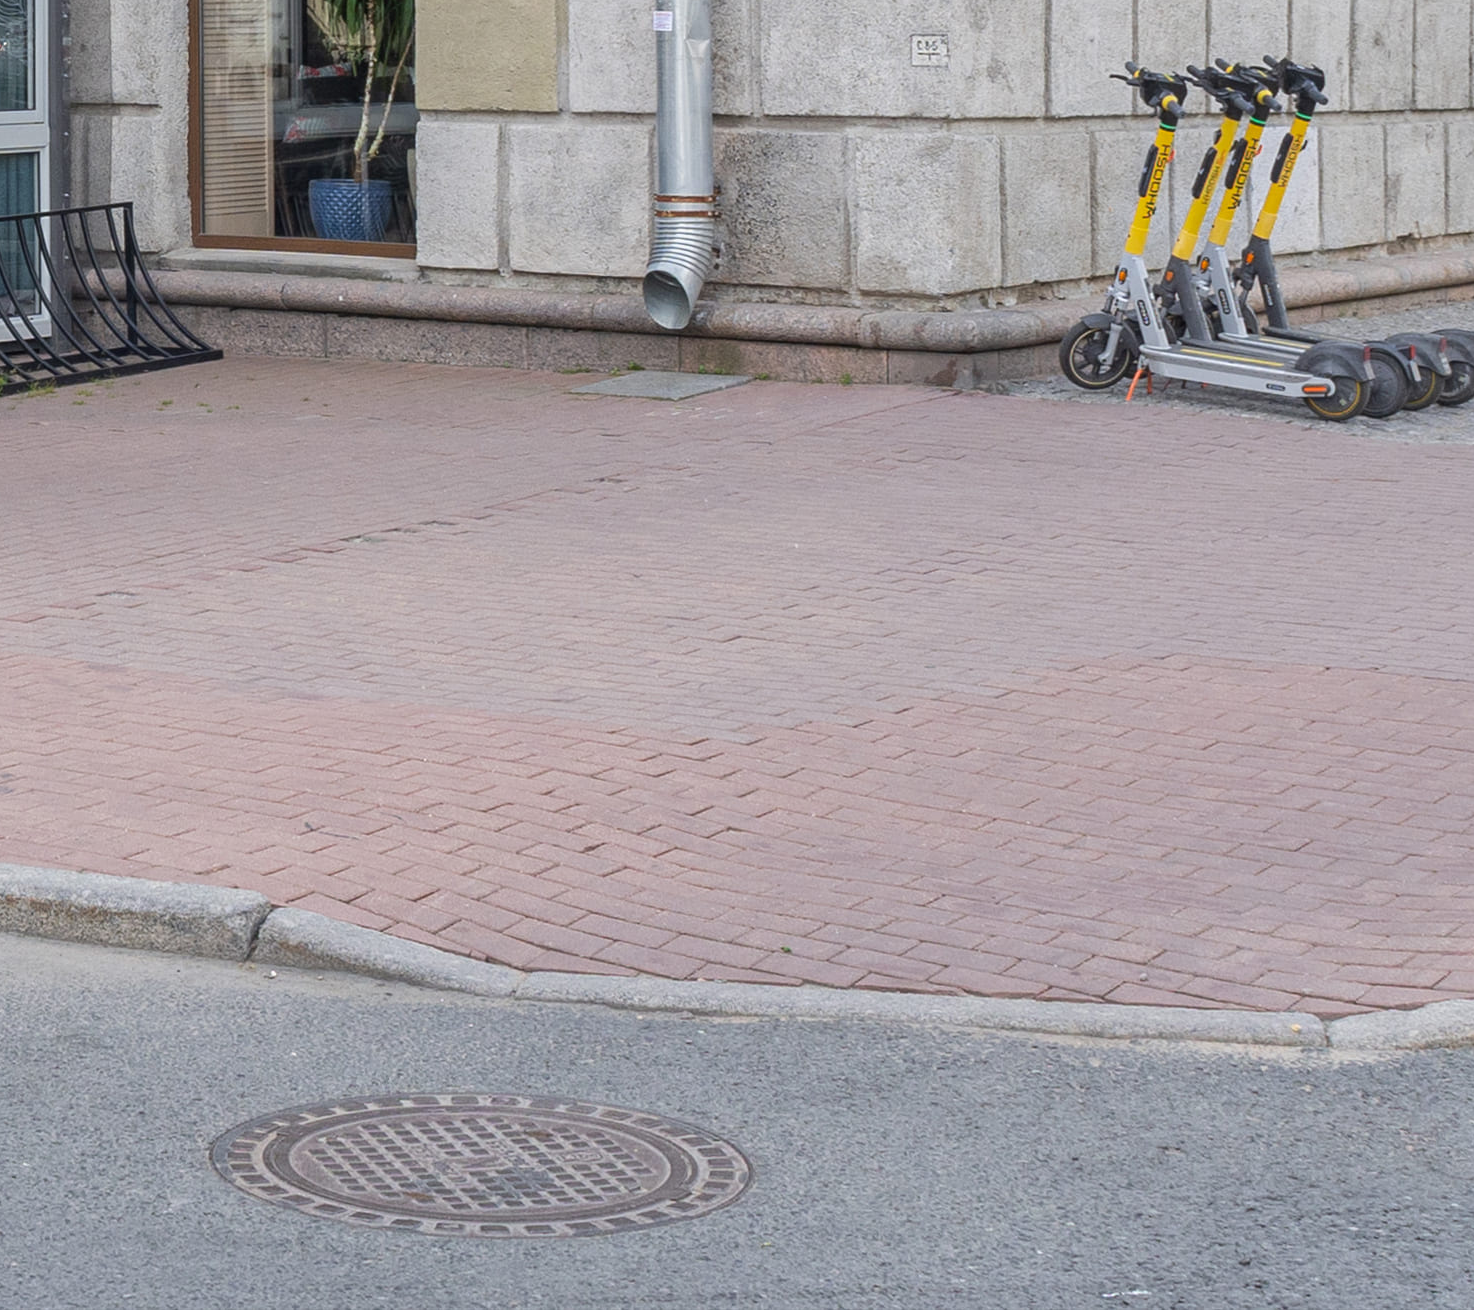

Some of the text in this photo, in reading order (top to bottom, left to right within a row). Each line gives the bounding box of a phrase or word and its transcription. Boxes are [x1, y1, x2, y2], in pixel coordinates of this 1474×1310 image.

[1142, 144, 1171, 219] WHOOSH
[1227, 138, 1259, 209] WHOOSH
[1277, 134, 1303, 188] WHOOSH
